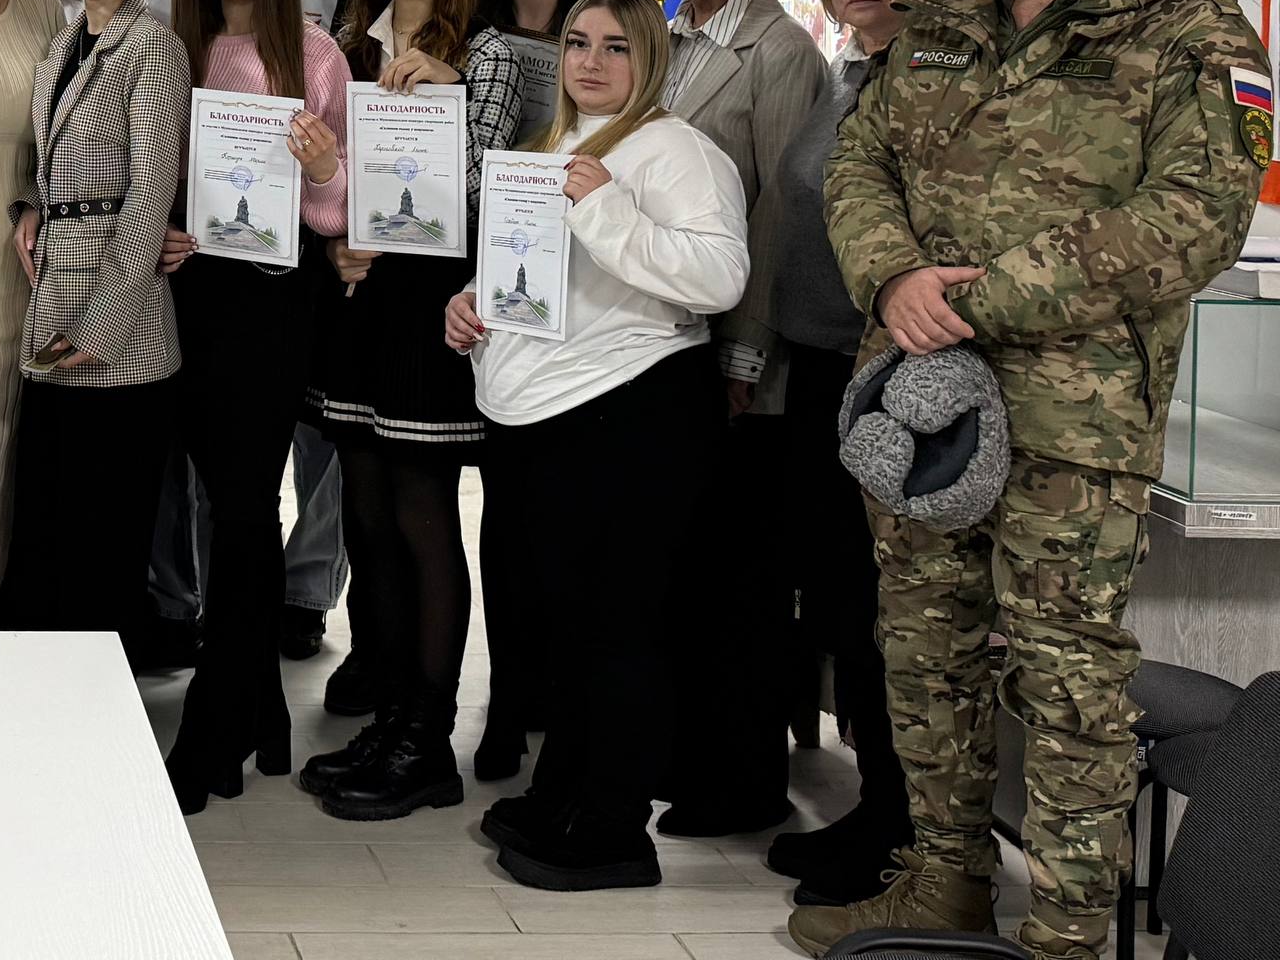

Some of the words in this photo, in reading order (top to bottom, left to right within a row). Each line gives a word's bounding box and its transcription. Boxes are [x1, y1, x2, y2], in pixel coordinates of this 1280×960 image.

[920, 51, 969, 65] РОССИЯ
[367, 104, 446, 115] БЛАГОДАРНОСТЬ
[209, 111, 284, 127] БЛАГОДАРНОСТЬ
[496, 173, 558, 186] БЛАГОДАРНОСТЬ
